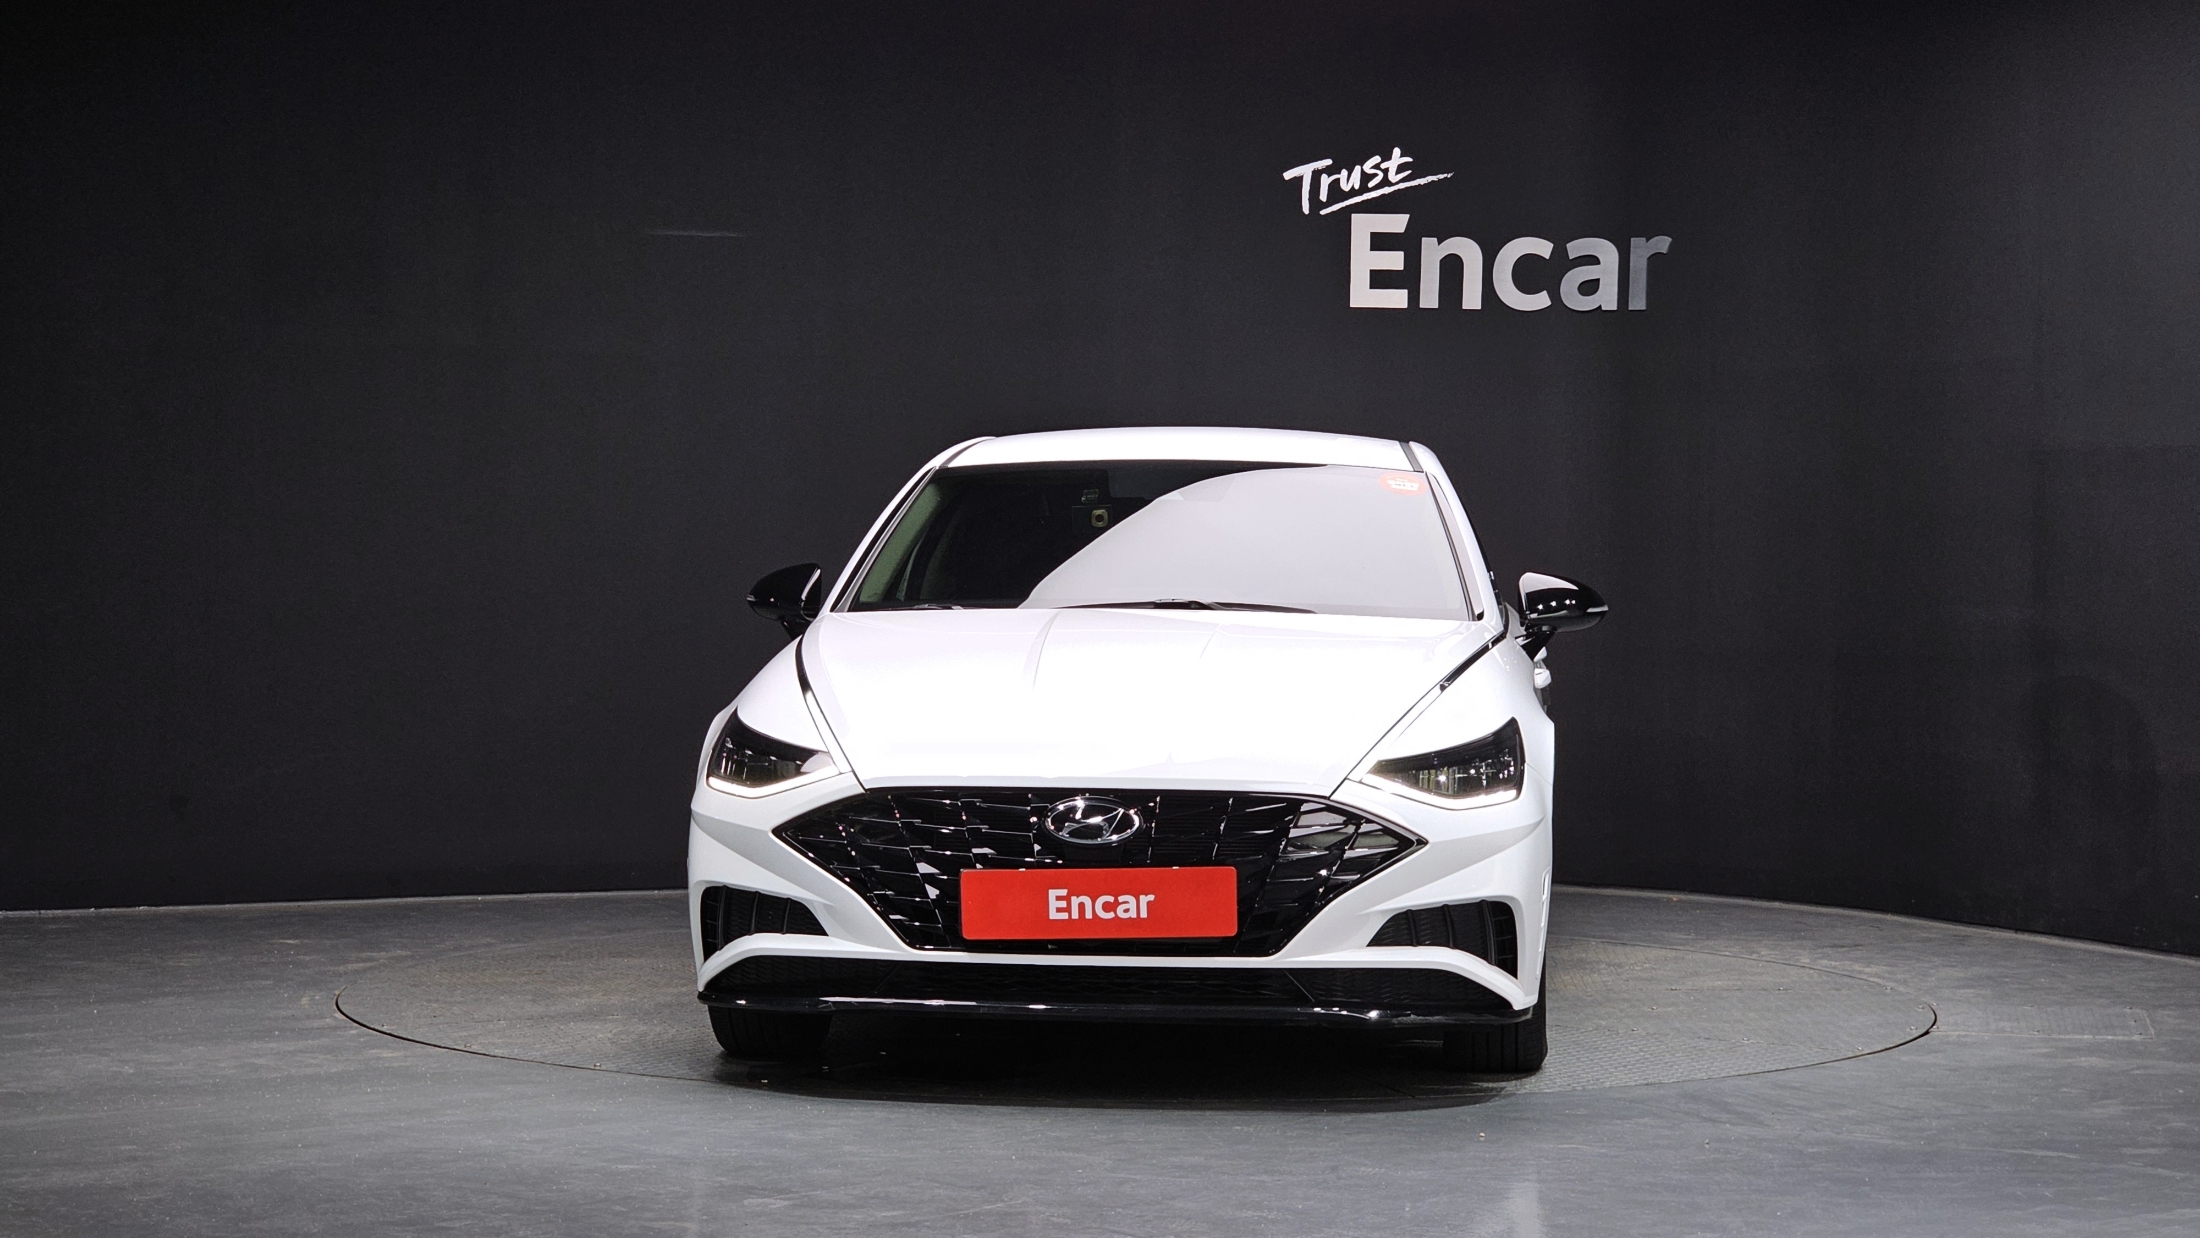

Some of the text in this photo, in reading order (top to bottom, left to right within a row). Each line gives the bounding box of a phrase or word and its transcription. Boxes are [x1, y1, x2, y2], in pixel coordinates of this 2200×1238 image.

[1283, 147, 1415, 215] Trust
[1349, 213, 1672, 311] Encar
[1048, 889, 1155, 919] Encar
